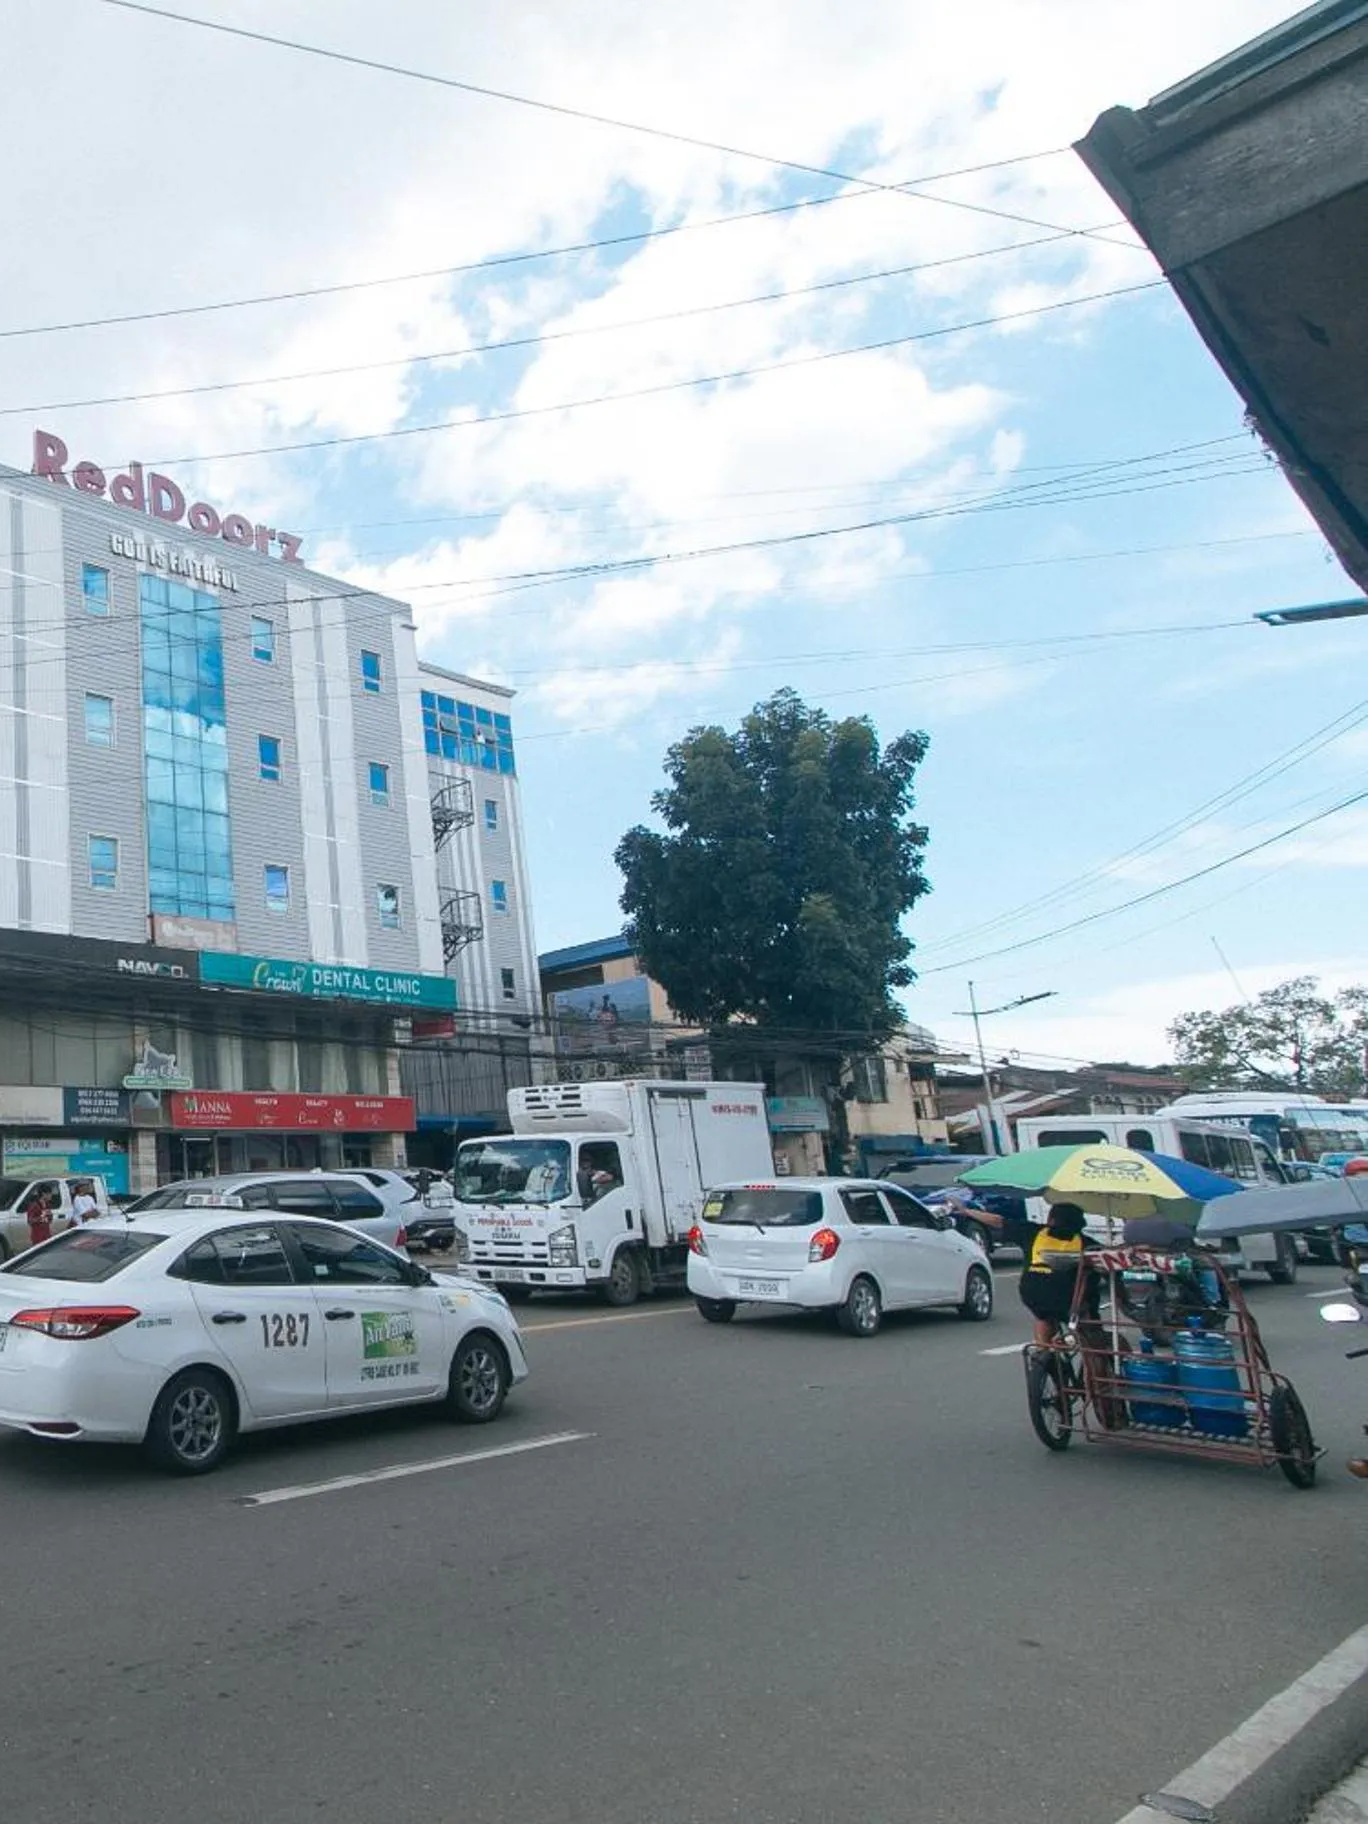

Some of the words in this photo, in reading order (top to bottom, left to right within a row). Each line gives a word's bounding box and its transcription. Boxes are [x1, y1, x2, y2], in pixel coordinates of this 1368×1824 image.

[33, 429, 304, 564] RedDoorz
[312, 969, 371, 991] DENTAL
[375, 976, 421, 996] CLINIC
[184, 1095, 233, 1113] MANNA
[261, 1313, 309, 1348] 1287
